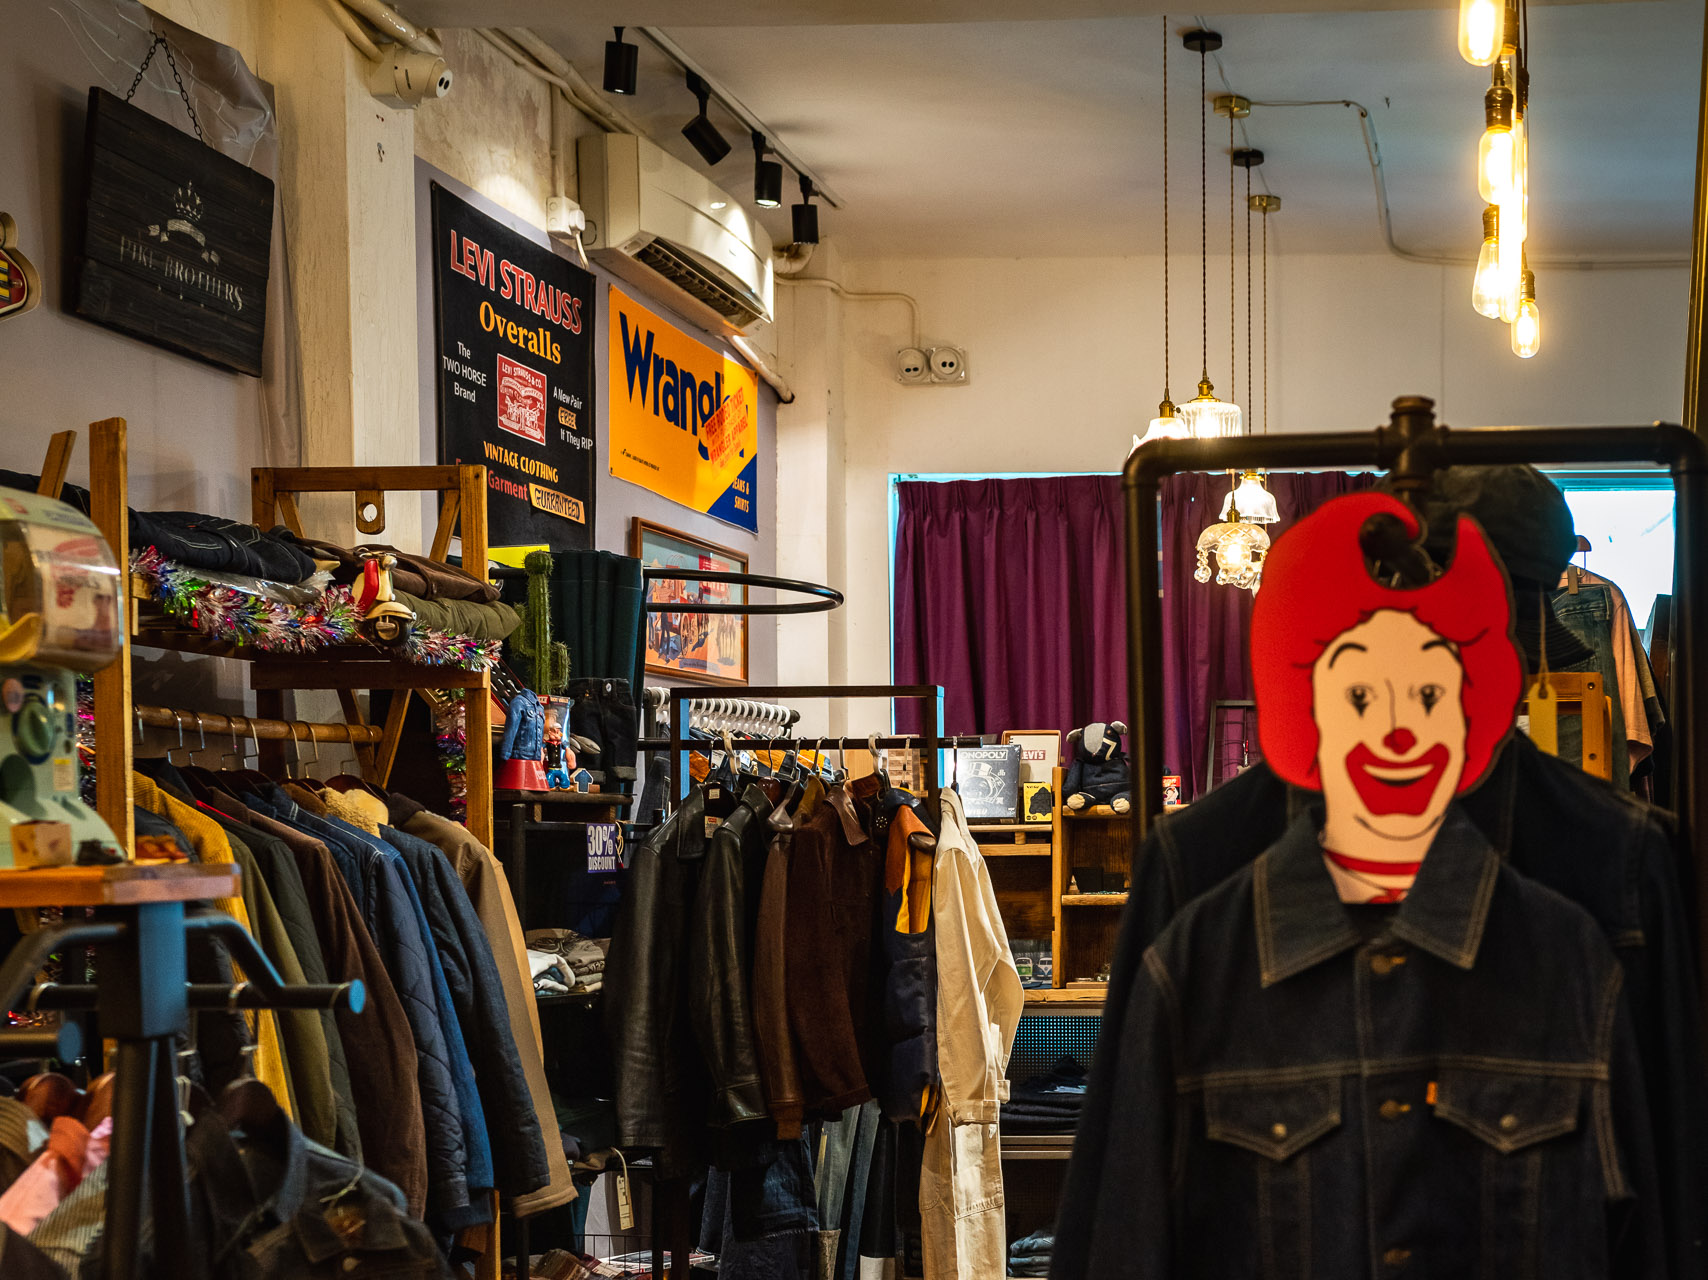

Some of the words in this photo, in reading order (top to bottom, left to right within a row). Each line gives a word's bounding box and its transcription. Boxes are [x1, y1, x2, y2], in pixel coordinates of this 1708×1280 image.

[450, 229, 496, 292] LEVI
[499, 258, 582, 335] STRAUSS
[479, 301, 562, 365] Overalls
[457, 341, 471, 360] The
[442, 355, 461, 376] TWO
[461, 365, 487, 388] HORSE
[618, 310, 748, 460] Wrangl
[454, 381, 476, 403] Brand
[558, 388, 571, 405] New
[570, 394, 583, 410] Pair
[566, 430, 581, 450] They
[581, 436, 594, 450] RIP
[483, 440, 519, 470] VINTAGE
[520, 456, 559, 484] CLOTHING
[487, 470, 528, 502] Garment
[958, 750, 1008, 761] ONOPOLY
[587, 825, 614, 856] 30%
[588, 856, 616, 871] DISCOUNT
